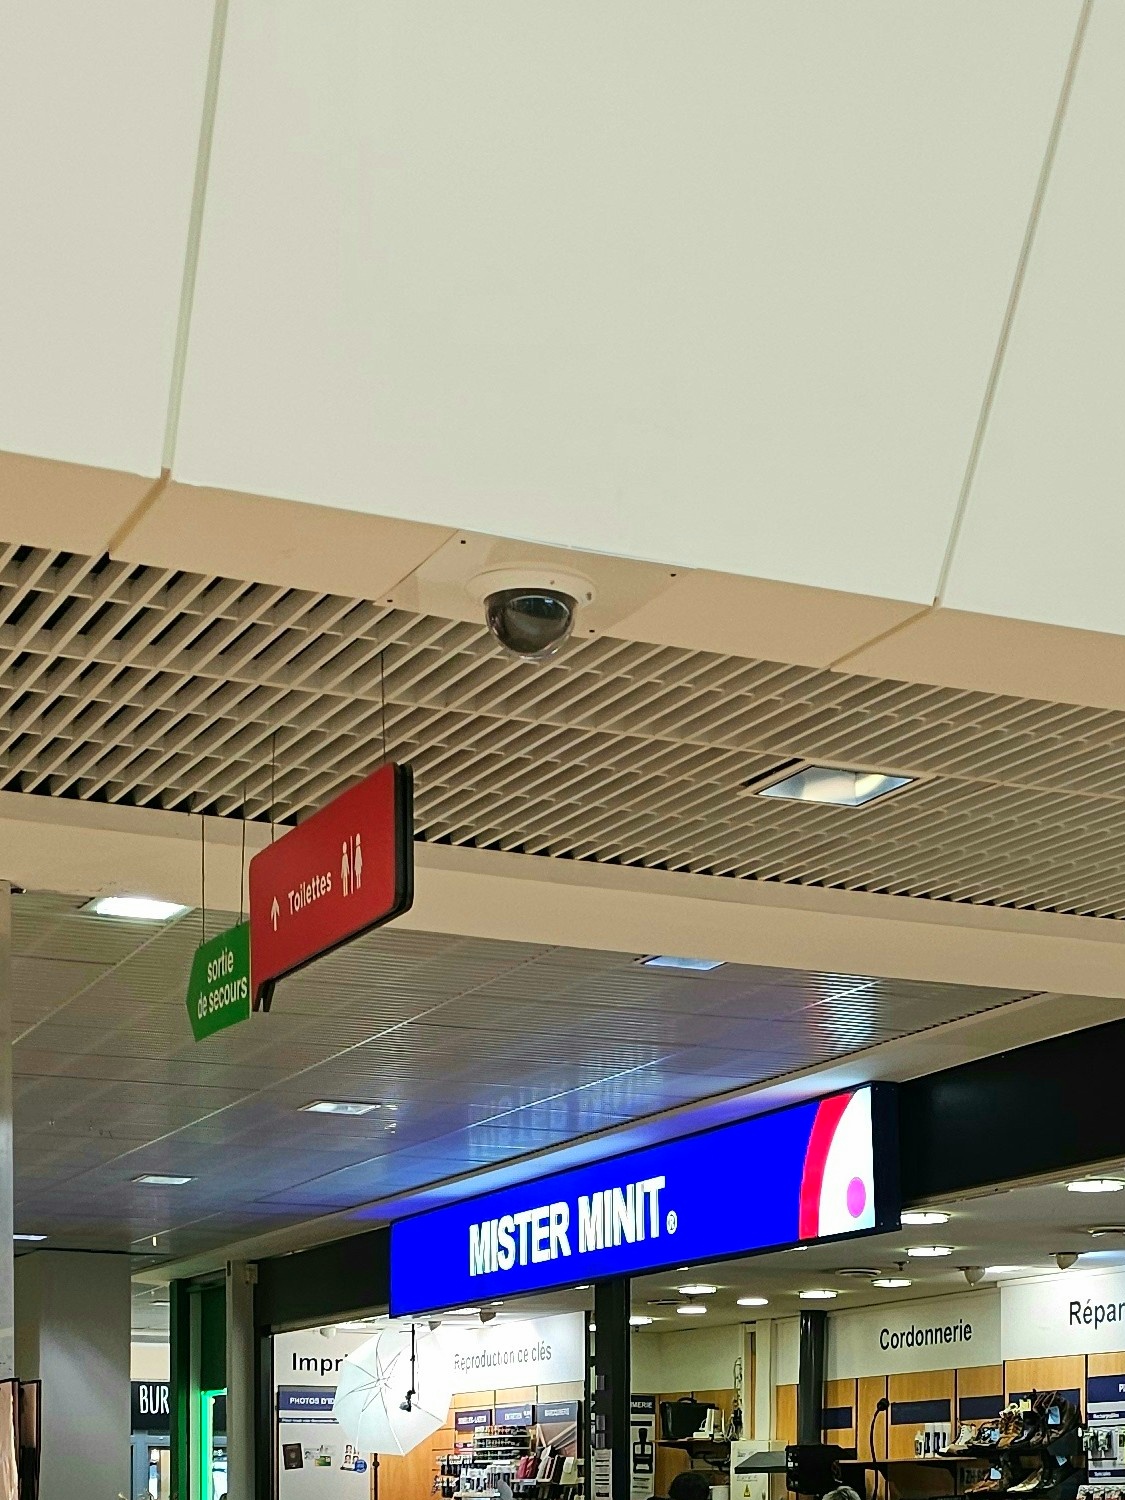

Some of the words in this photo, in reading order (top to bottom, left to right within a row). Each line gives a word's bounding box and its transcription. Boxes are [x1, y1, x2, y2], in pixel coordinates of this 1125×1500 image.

[288, 872, 332, 915] Toilettes
[207, 946, 234, 983] sortie
[197, 992, 207, 1019] de
[208, 976, 248, 1014] secours
[469, 1201, 572, 1277] MISTER
[879, 1318, 973, 1351] Cordonnerie
[292, 1352, 348, 1377] Impr
[453, 1348, 515, 1374] Reproduction
[531, 1340, 552, 1362] clés
[139, 1384, 170, 1415] BUR
[289, 1396, 320, 1405] PHOTOS
